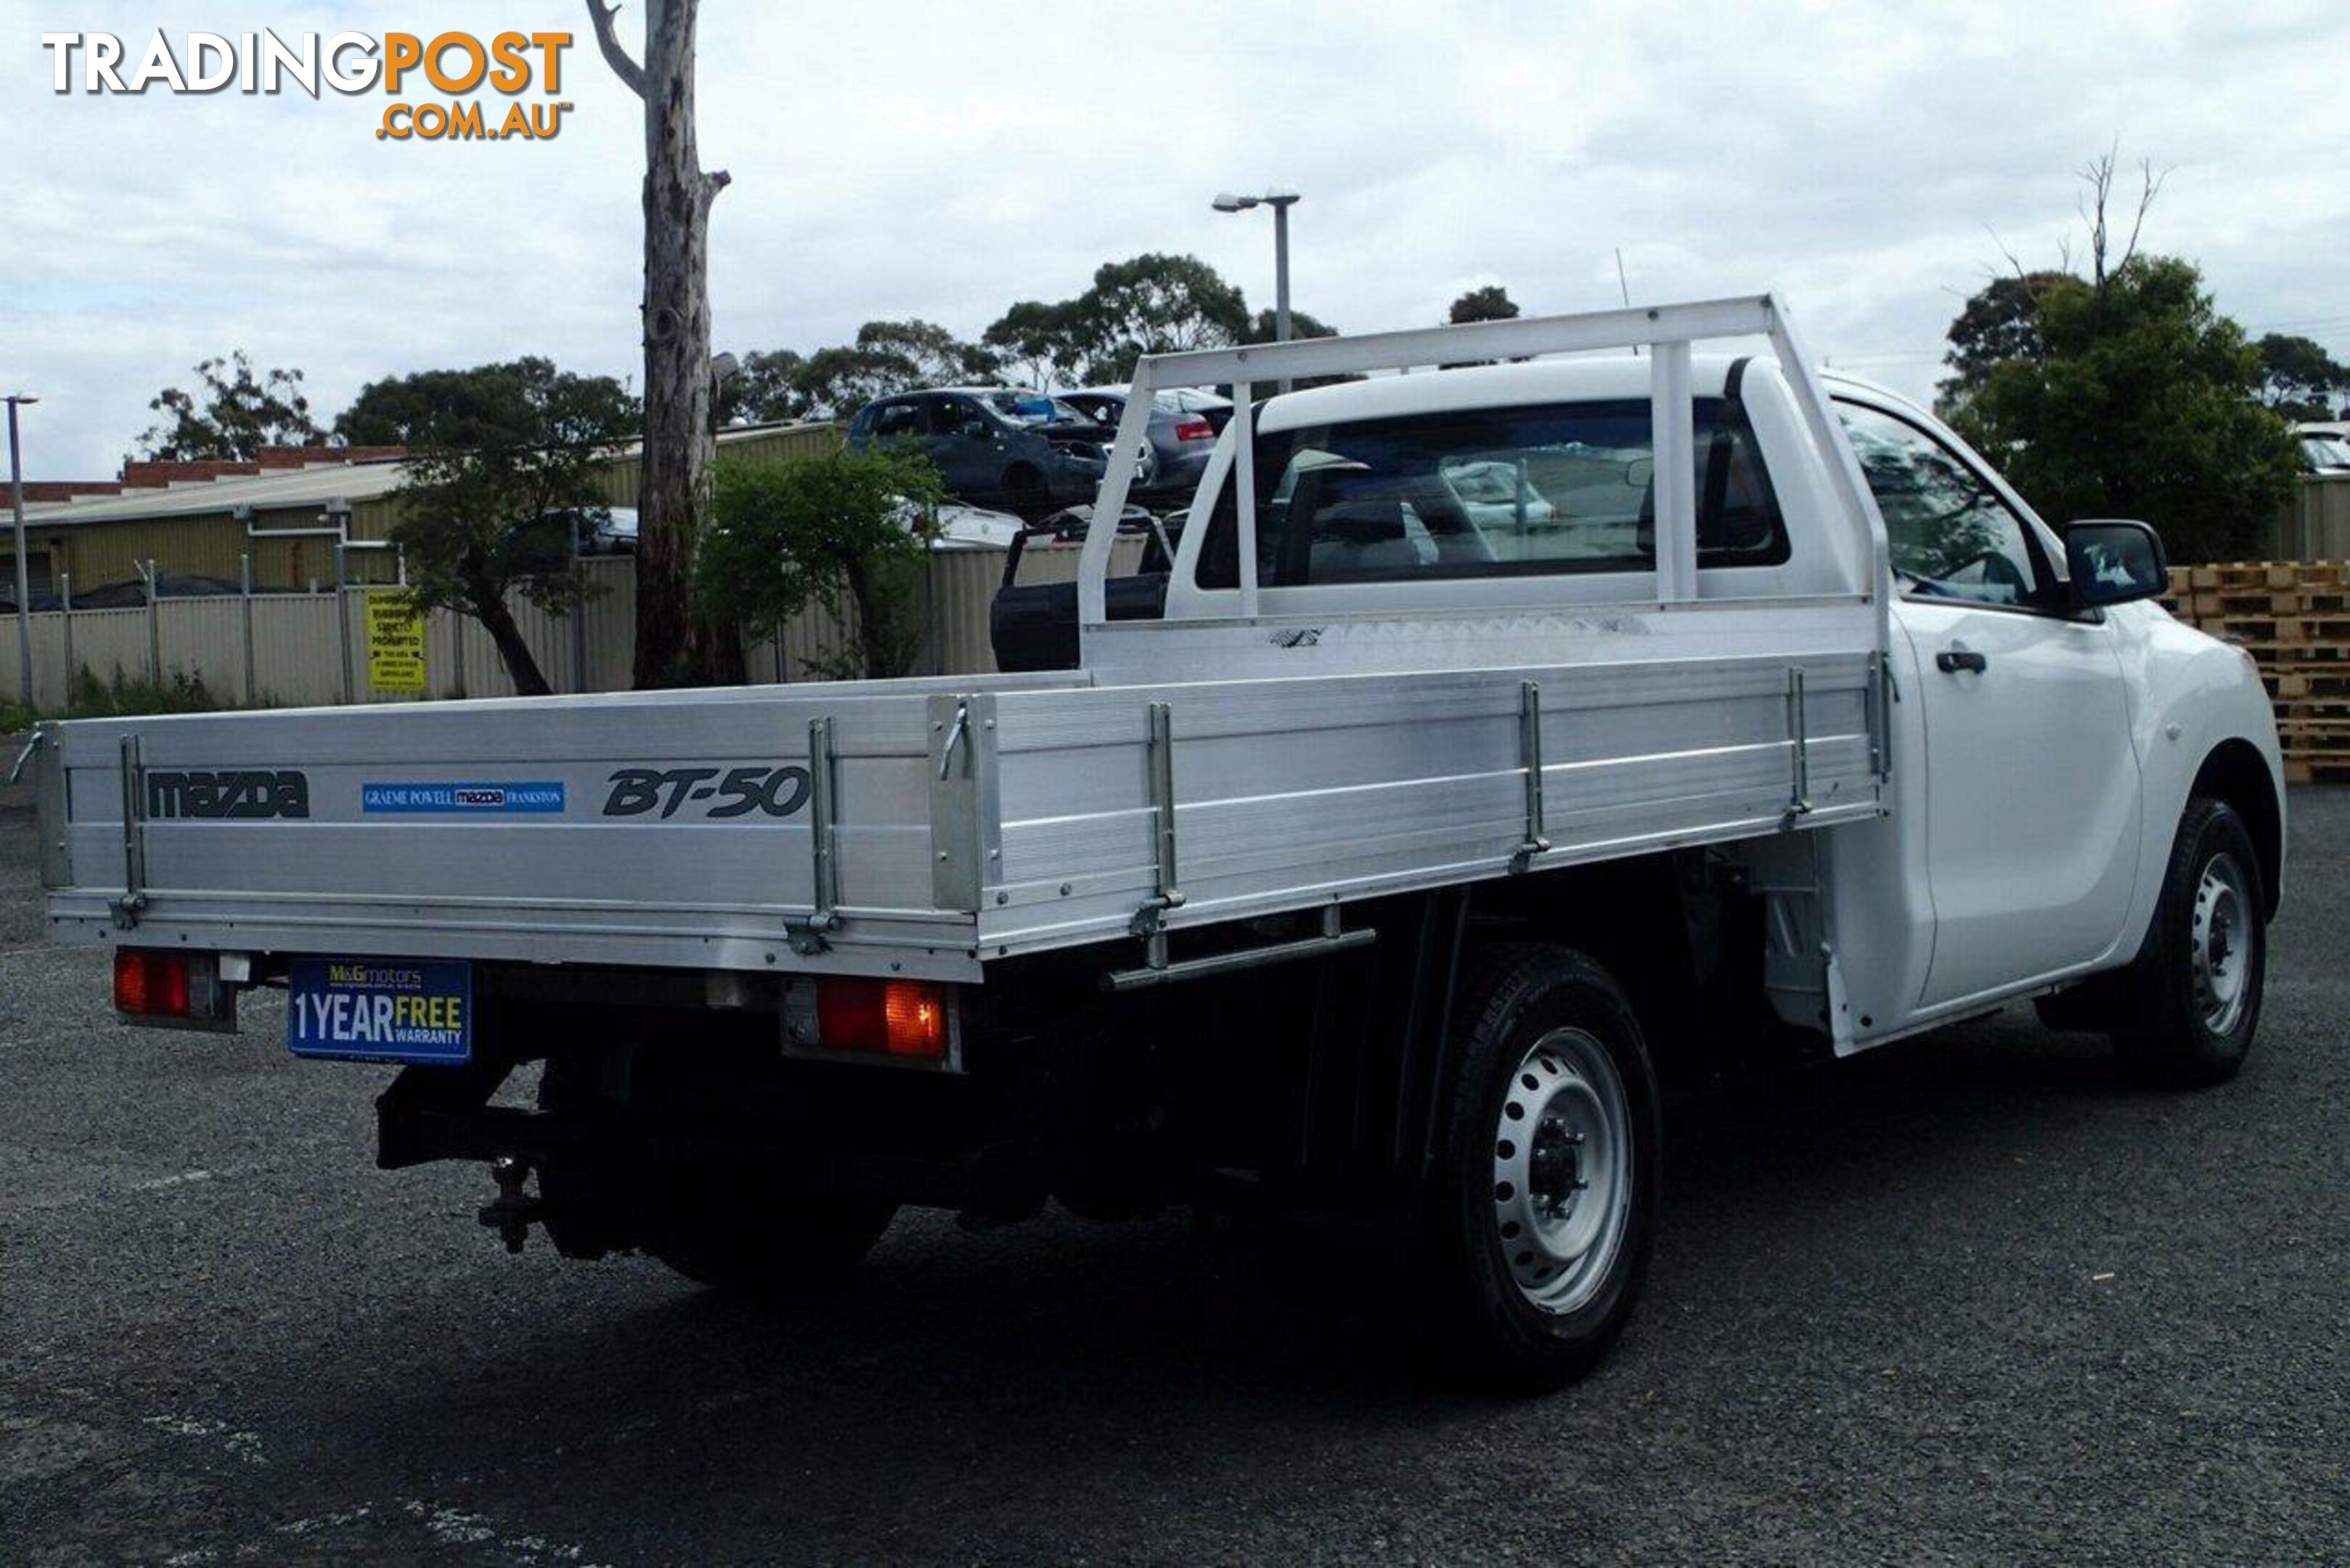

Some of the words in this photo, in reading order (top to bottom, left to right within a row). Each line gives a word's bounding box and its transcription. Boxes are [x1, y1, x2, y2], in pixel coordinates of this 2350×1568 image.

[410, 789, 452, 805] POWELL
[507, 790, 562, 804] FRANKSTON
[603, 766, 810, 820] BT-50
[396, 996, 462, 1029] FREE
[396, 1029, 462, 1045] WARRANTY
